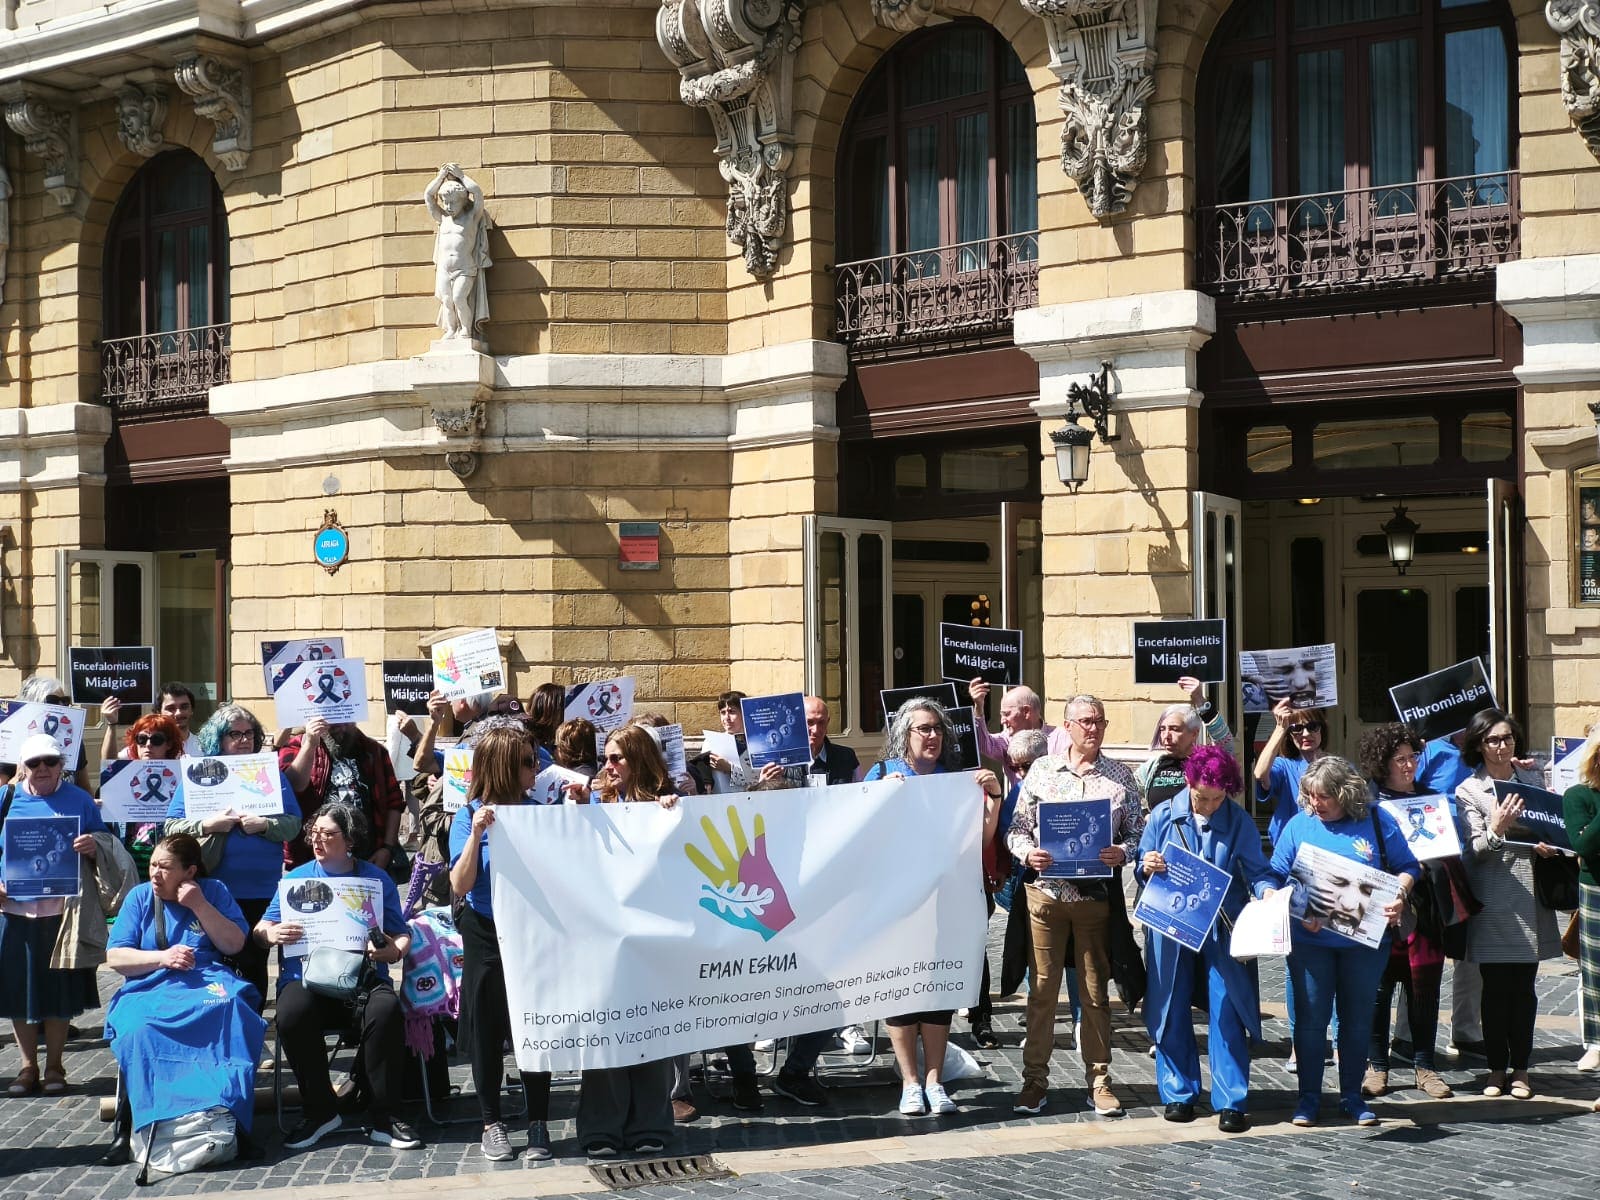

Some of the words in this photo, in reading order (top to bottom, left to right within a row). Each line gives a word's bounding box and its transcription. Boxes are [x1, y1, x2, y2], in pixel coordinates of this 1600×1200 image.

[943, 637, 1018, 653] Encefalomielitis
[1137, 635, 1221, 647] Encefalomielitis
[73, 661, 149, 671] Encefalomielitis
[955, 653, 1005, 670] Miálgica
[1151, 653, 1208, 668] Miálgica
[85, 676, 137, 690] Miálgica
[384, 672, 433, 683] Encefalomielit
[391, 687, 430, 701] Miálgica
[1403, 684, 1487, 723] Fibromialgia
[1521, 808, 1566, 829] romialg
[699, 959, 744, 980] EMAN
[749, 952, 798, 975] ESKUA
[523, 1008, 621, 1026] Fibromialgia
[626, 1004, 648, 1019] eta
[651, 998, 684, 1013] Neke
[688, 989, 771, 1007] Kronikoaren
[775, 975, 863, 999] Sindromearen
[866, 966, 910, 984] Bizkaiko
[913, 959, 963, 974] Elkartea
[522, 1034, 610, 1051] Asociación
[615, 1023, 670, 1045] Vizcaína
[674, 1019, 691, 1034] de
[695, 1011, 778, 1030] Fibromialgia
[782, 1009, 790, 1021] y
[854, 993, 871, 1007] de
[874, 986, 910, 1004] Fatiga
[912, 980, 964, 994] Crónica
